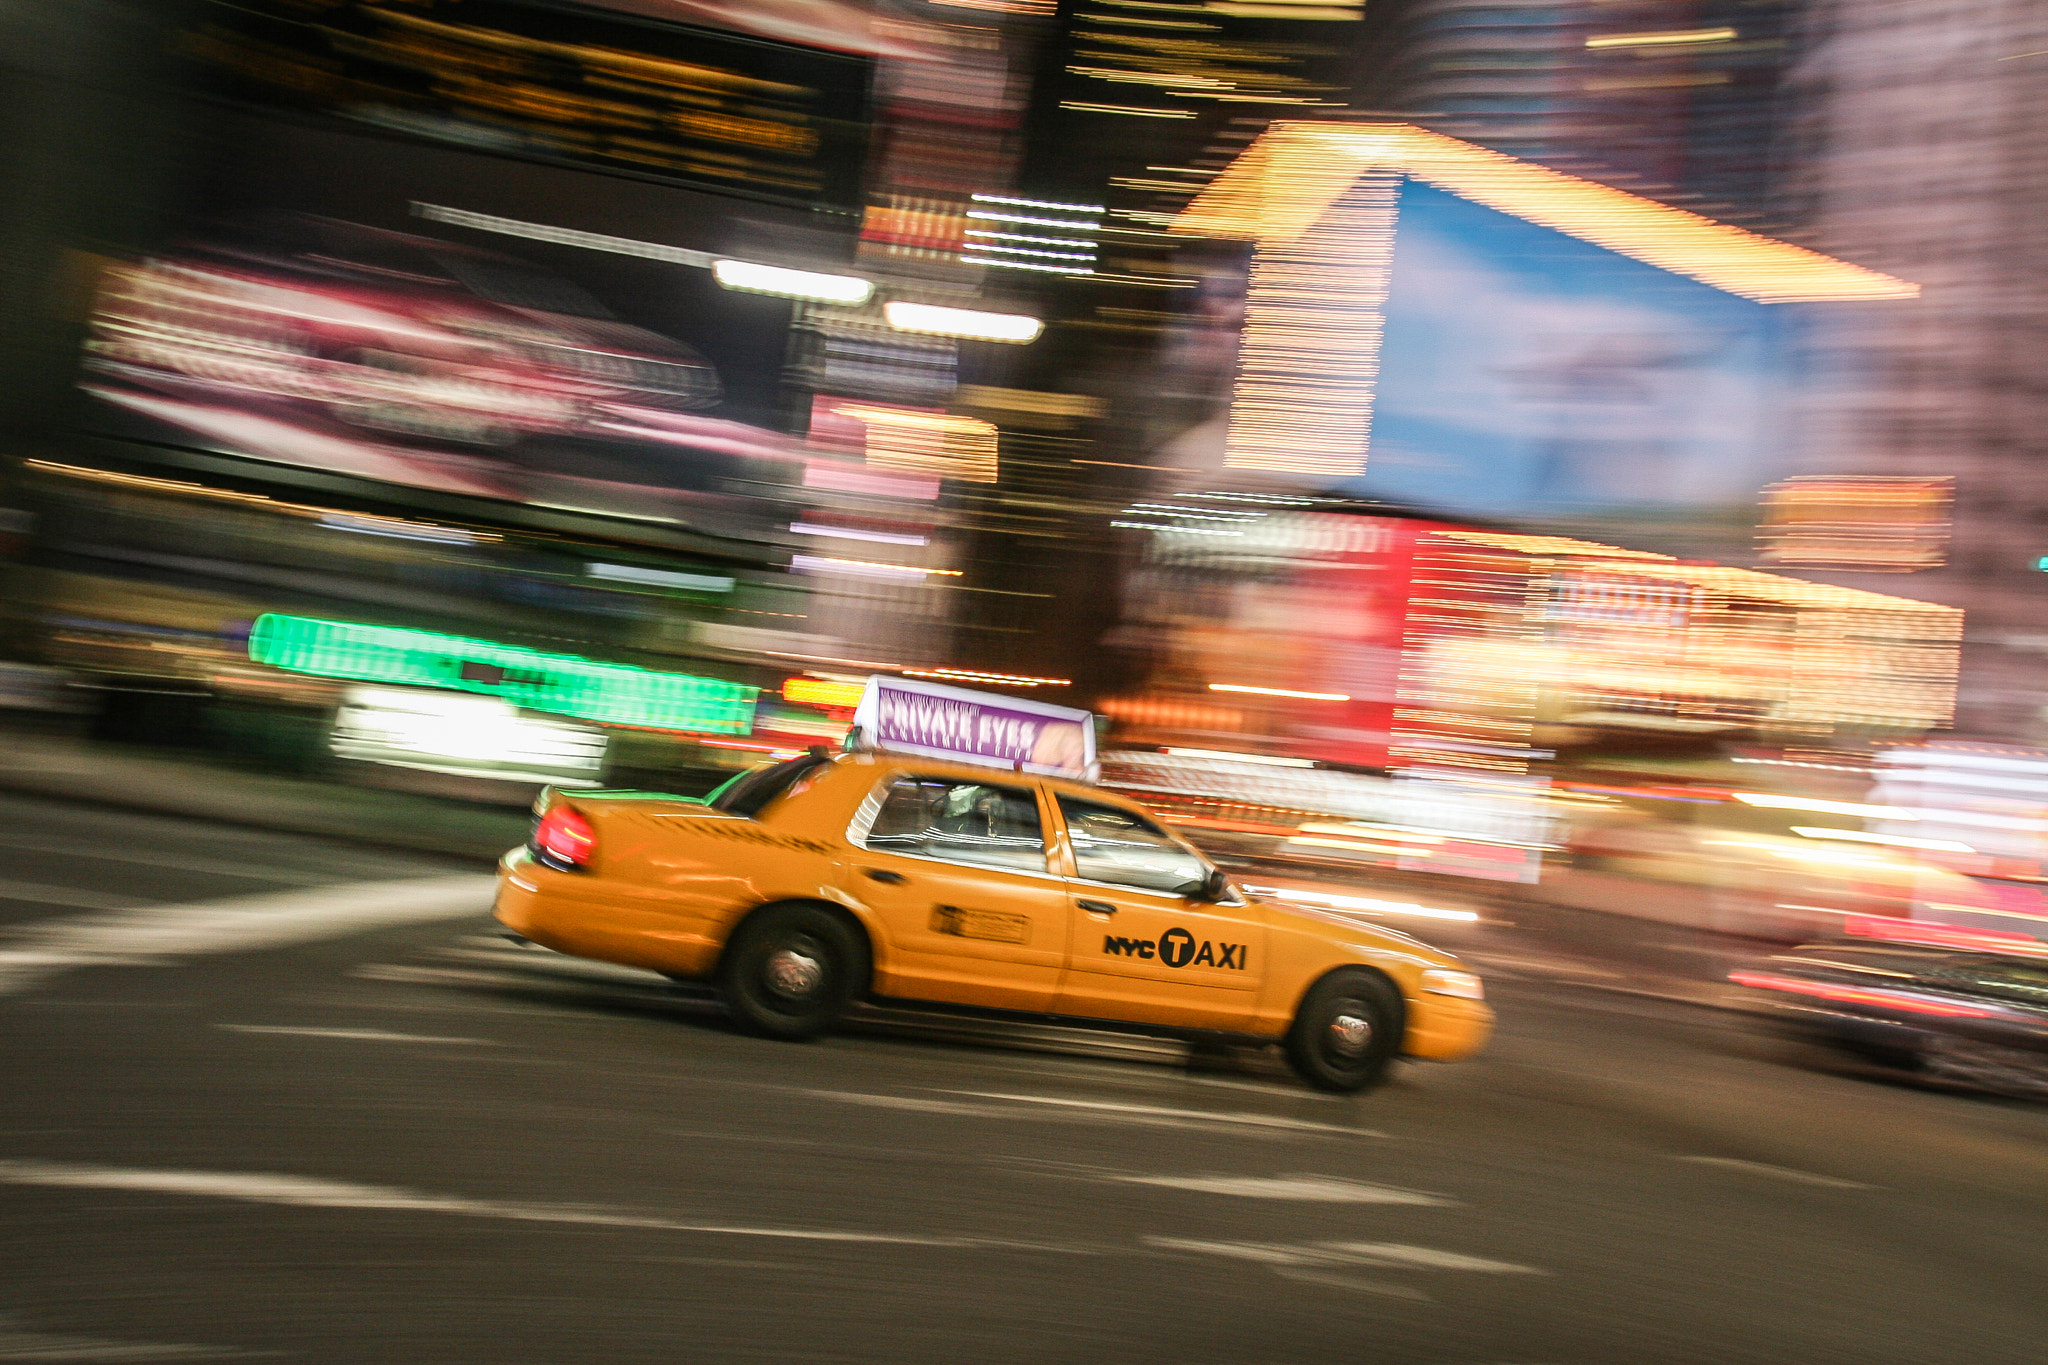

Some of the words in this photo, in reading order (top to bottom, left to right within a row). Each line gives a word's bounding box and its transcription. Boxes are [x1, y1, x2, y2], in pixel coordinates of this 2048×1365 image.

[880, 698, 971, 739] PRIVATE
[980, 714, 1036, 750] EYES
[1103, 934, 1156, 960] NYC
[1159, 928, 1246, 970] TAXI
